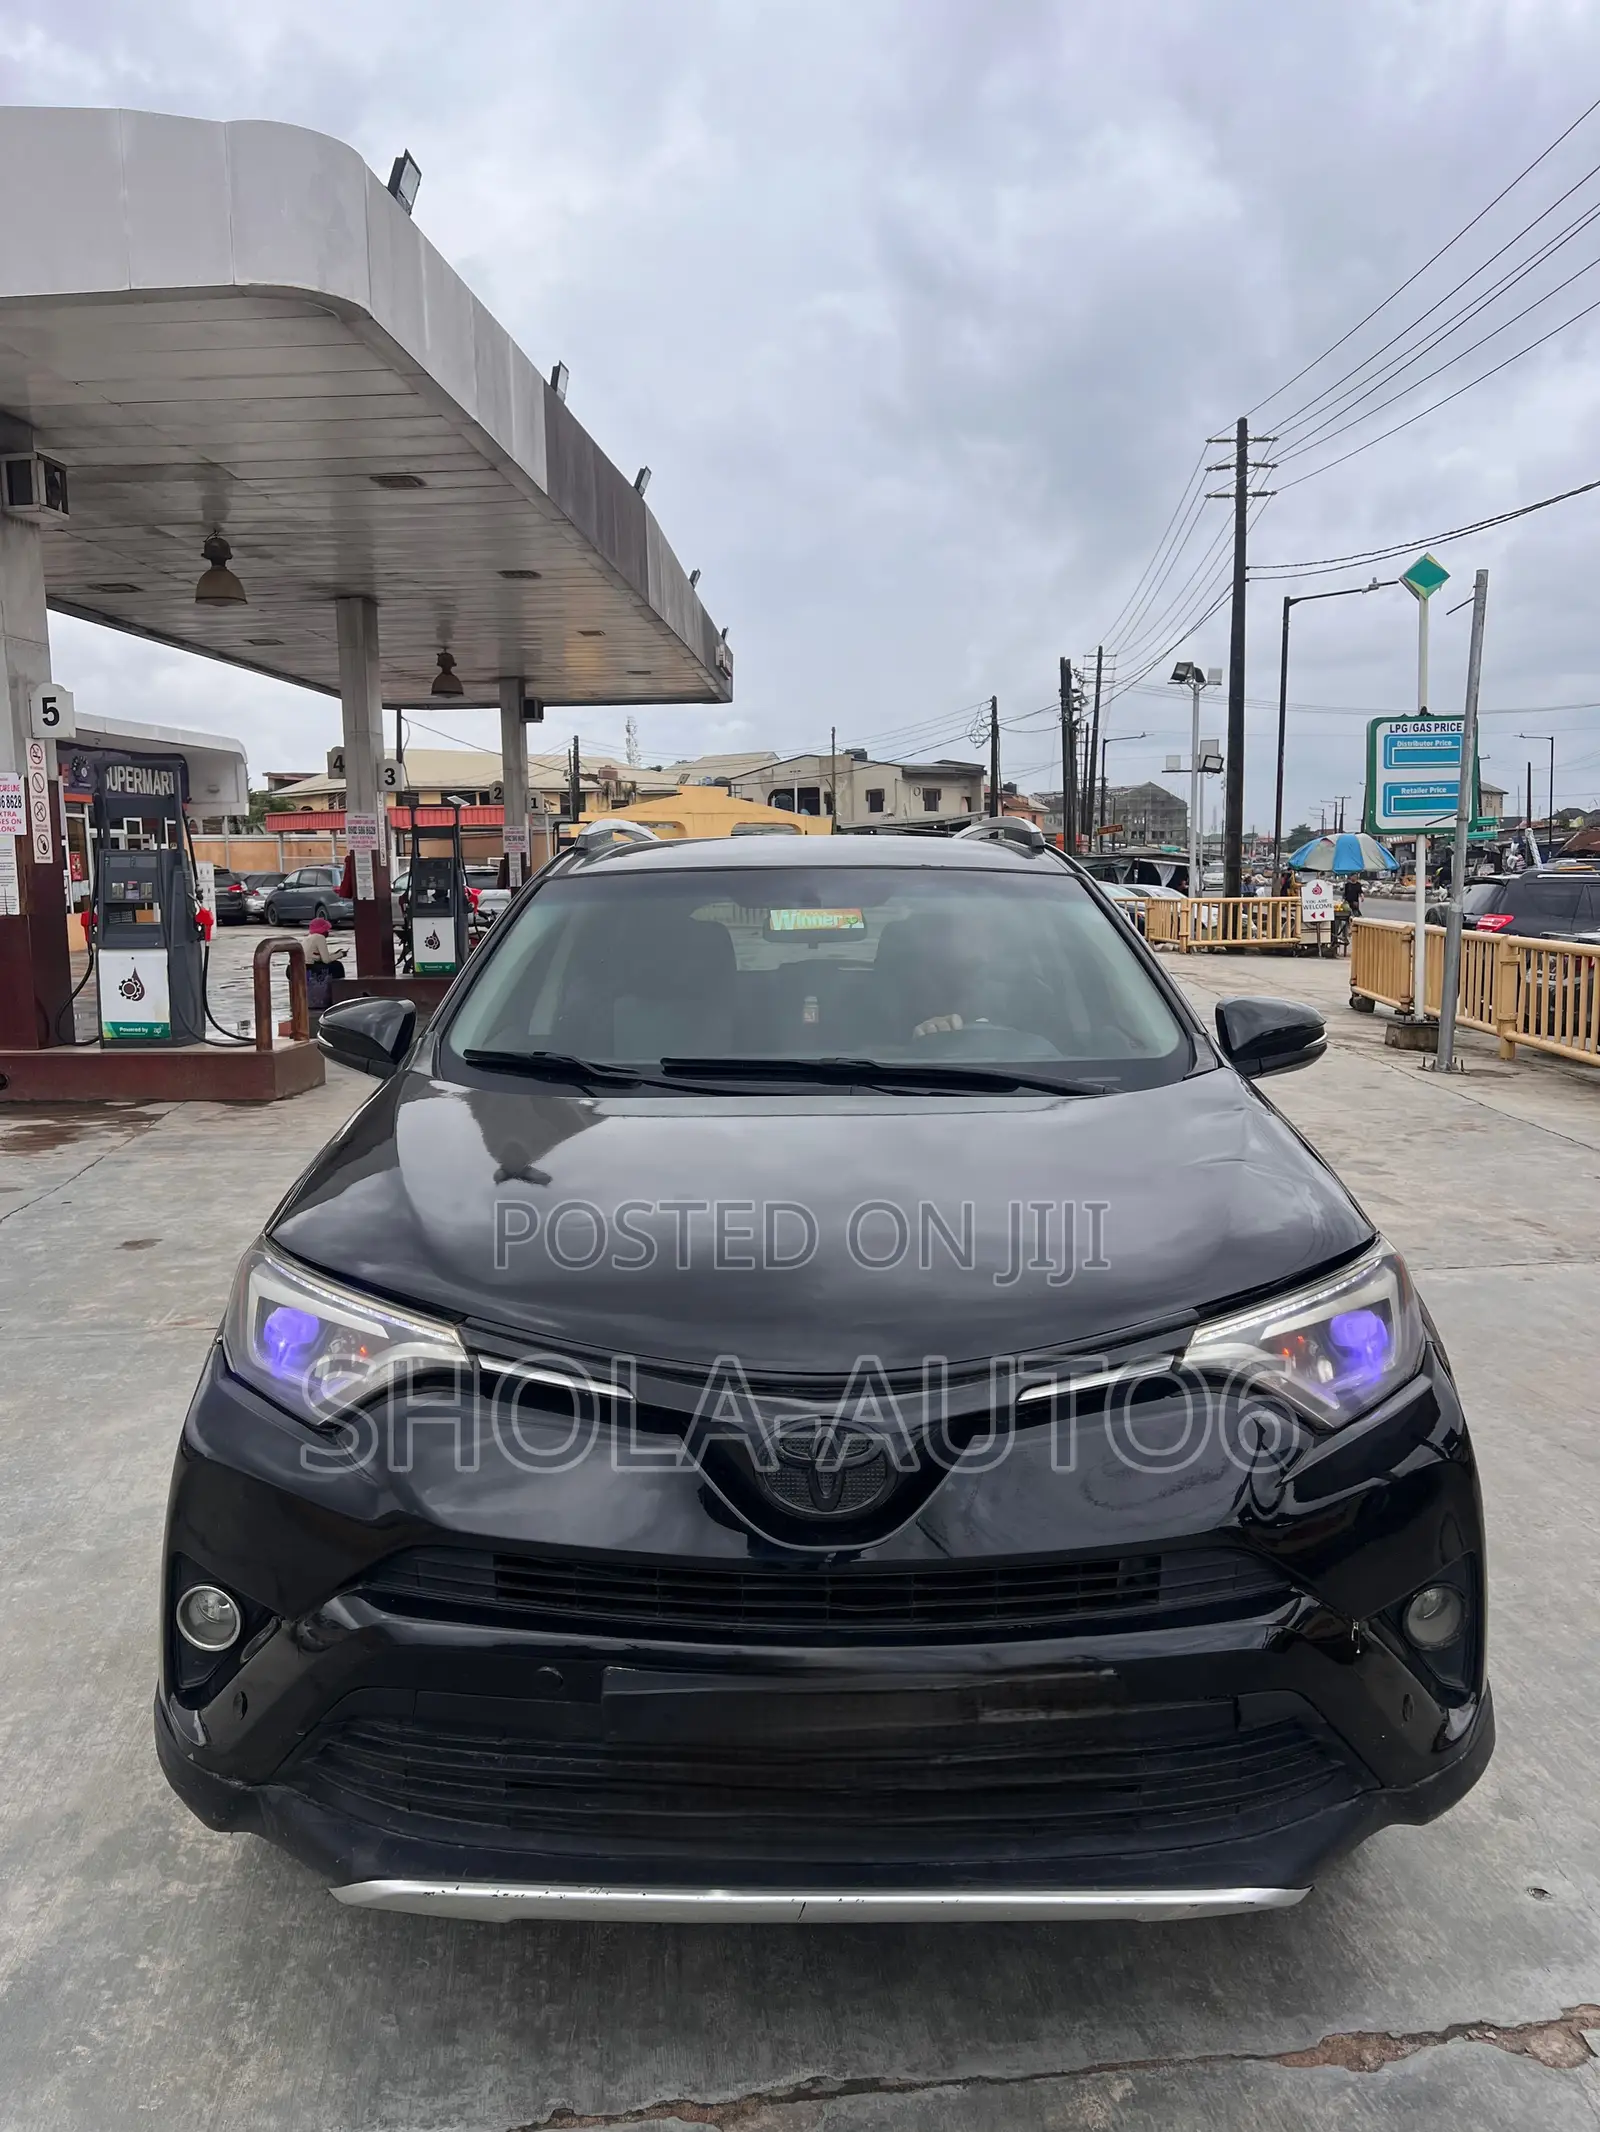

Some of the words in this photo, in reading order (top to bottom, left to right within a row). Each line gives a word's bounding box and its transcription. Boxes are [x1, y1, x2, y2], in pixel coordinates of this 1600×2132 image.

[42, 696, 60, 726] 5
[1434, 722, 1462, 732] PRICE
[333, 754, 345, 773] 4
[384, 767, 396, 786] 3
[11, 784, 20, 792] LINE
[493, 787, 503, 800] 2
[531, 797, 539, 809] 1
[141, 1026, 149, 1034] by
